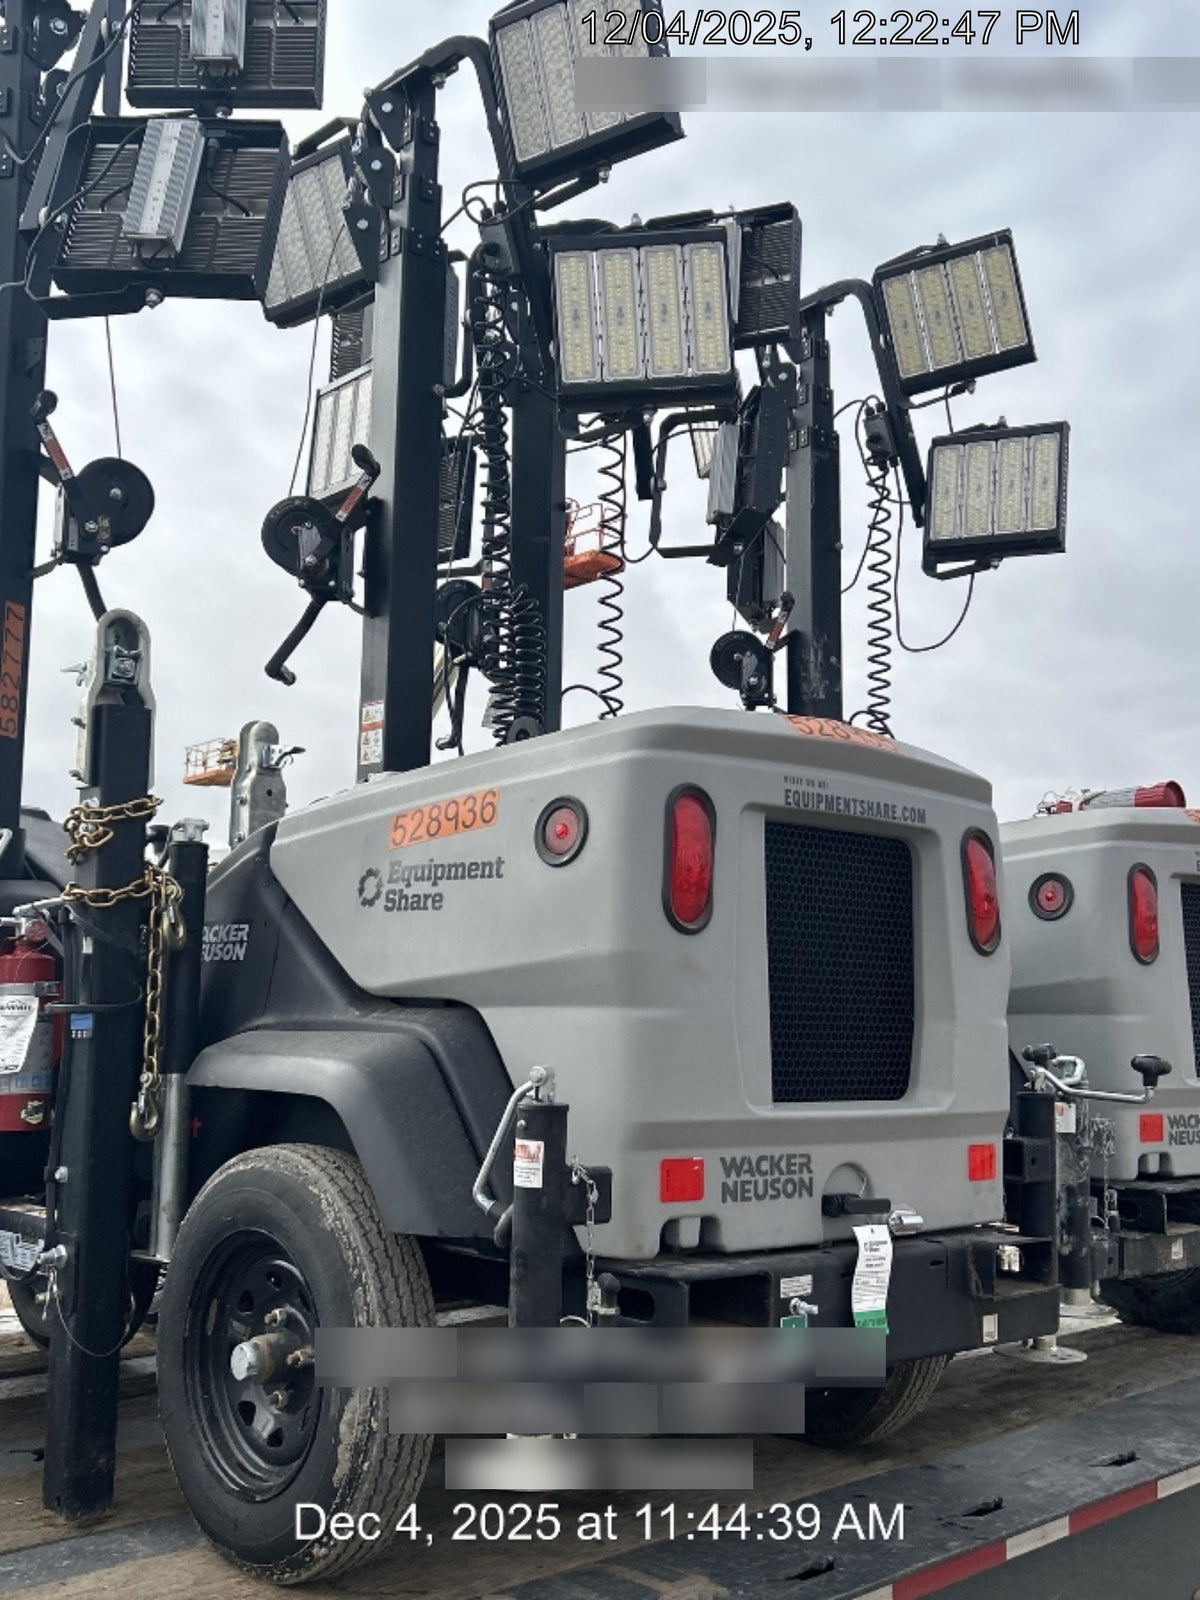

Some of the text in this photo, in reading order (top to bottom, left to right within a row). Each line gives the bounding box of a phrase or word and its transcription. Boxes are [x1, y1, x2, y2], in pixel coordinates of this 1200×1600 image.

[0, 605, 24, 735] 582777
[391, 789, 498, 847] 528936
[783, 789, 927, 824] EQUIPMENTSHARE.COM
[387, 856, 506, 888] Equipment
[383, 888, 444, 912] Share
[202, 923, 250, 943] ACKER
[202, 942, 248, 962] USON
[719, 1153, 814, 1179] WACKER
[721, 1177, 814, 1204] NEUSON
